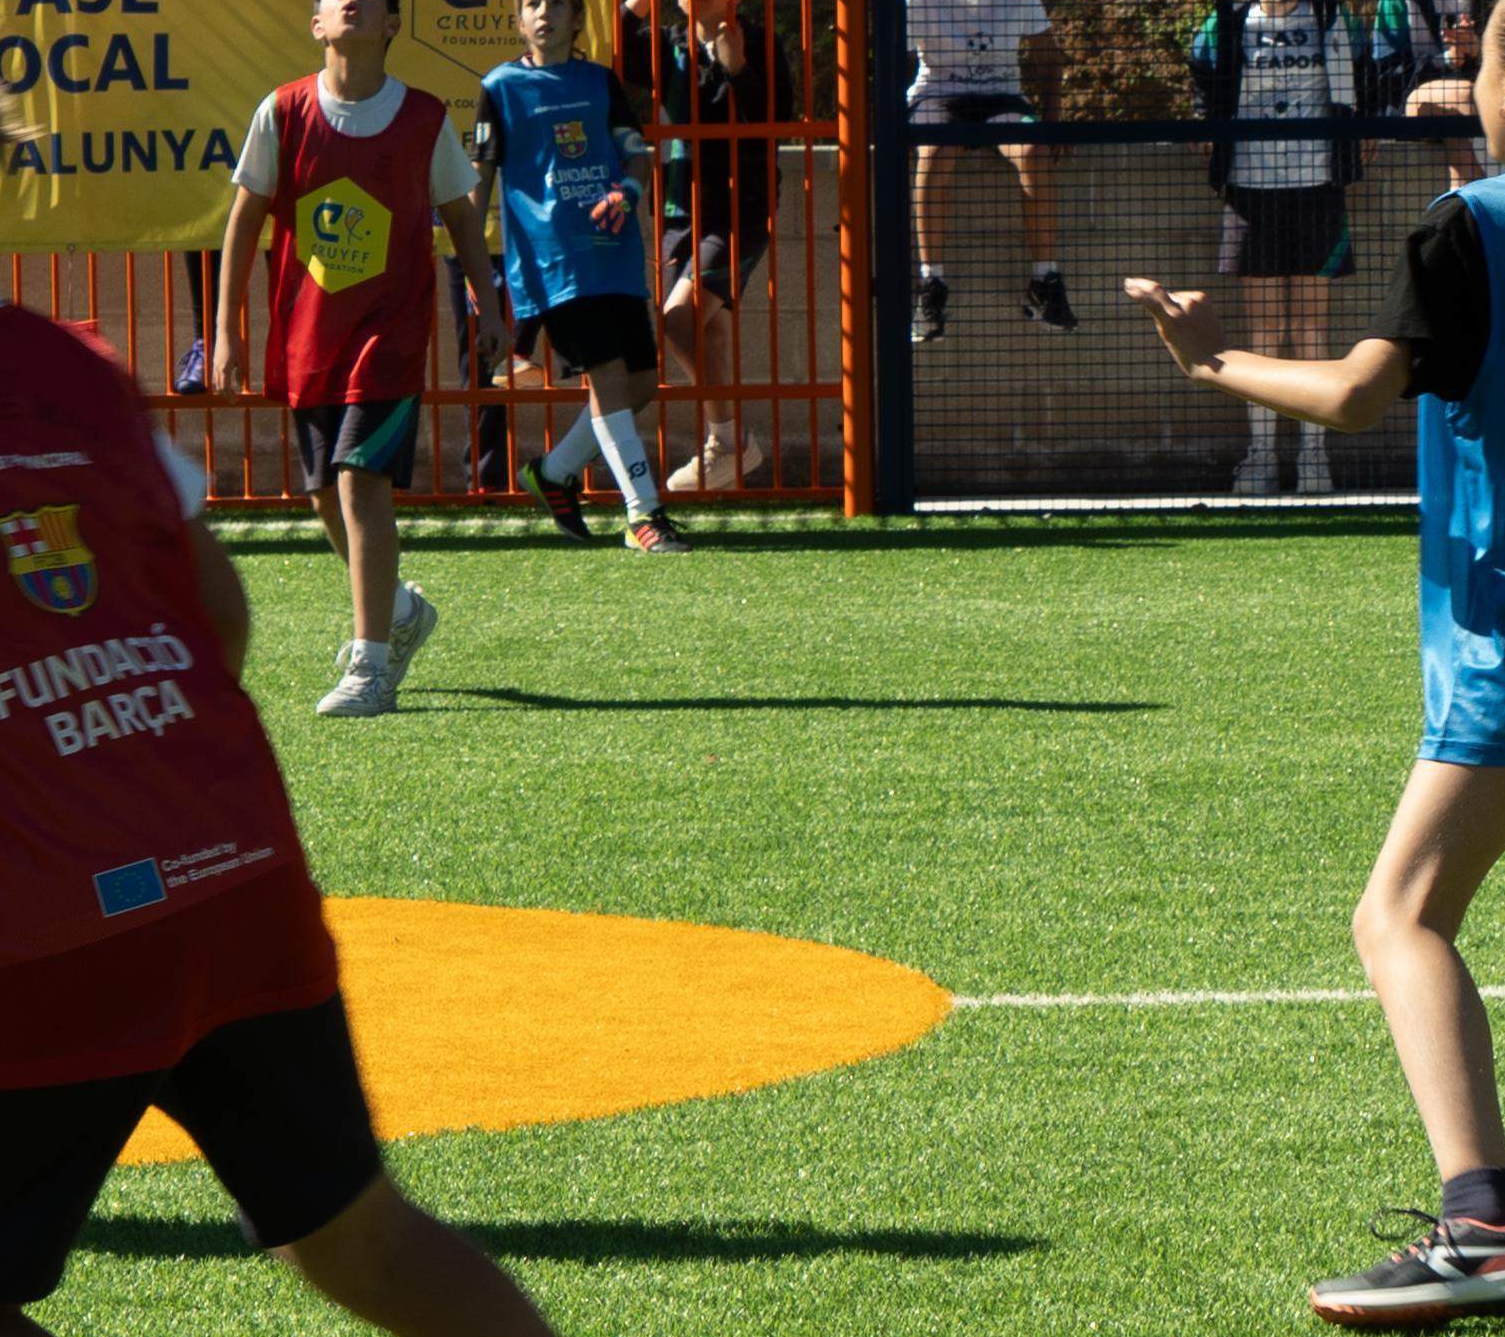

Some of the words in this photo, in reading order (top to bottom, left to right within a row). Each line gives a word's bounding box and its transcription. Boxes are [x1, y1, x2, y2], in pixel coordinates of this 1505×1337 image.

[436, 14, 518, 31] CRUYF
[8, 128, 237, 175] ALUNYA
[310, 243, 370, 263] CRUYFF
[44, 679, 195, 757] BARÇA
